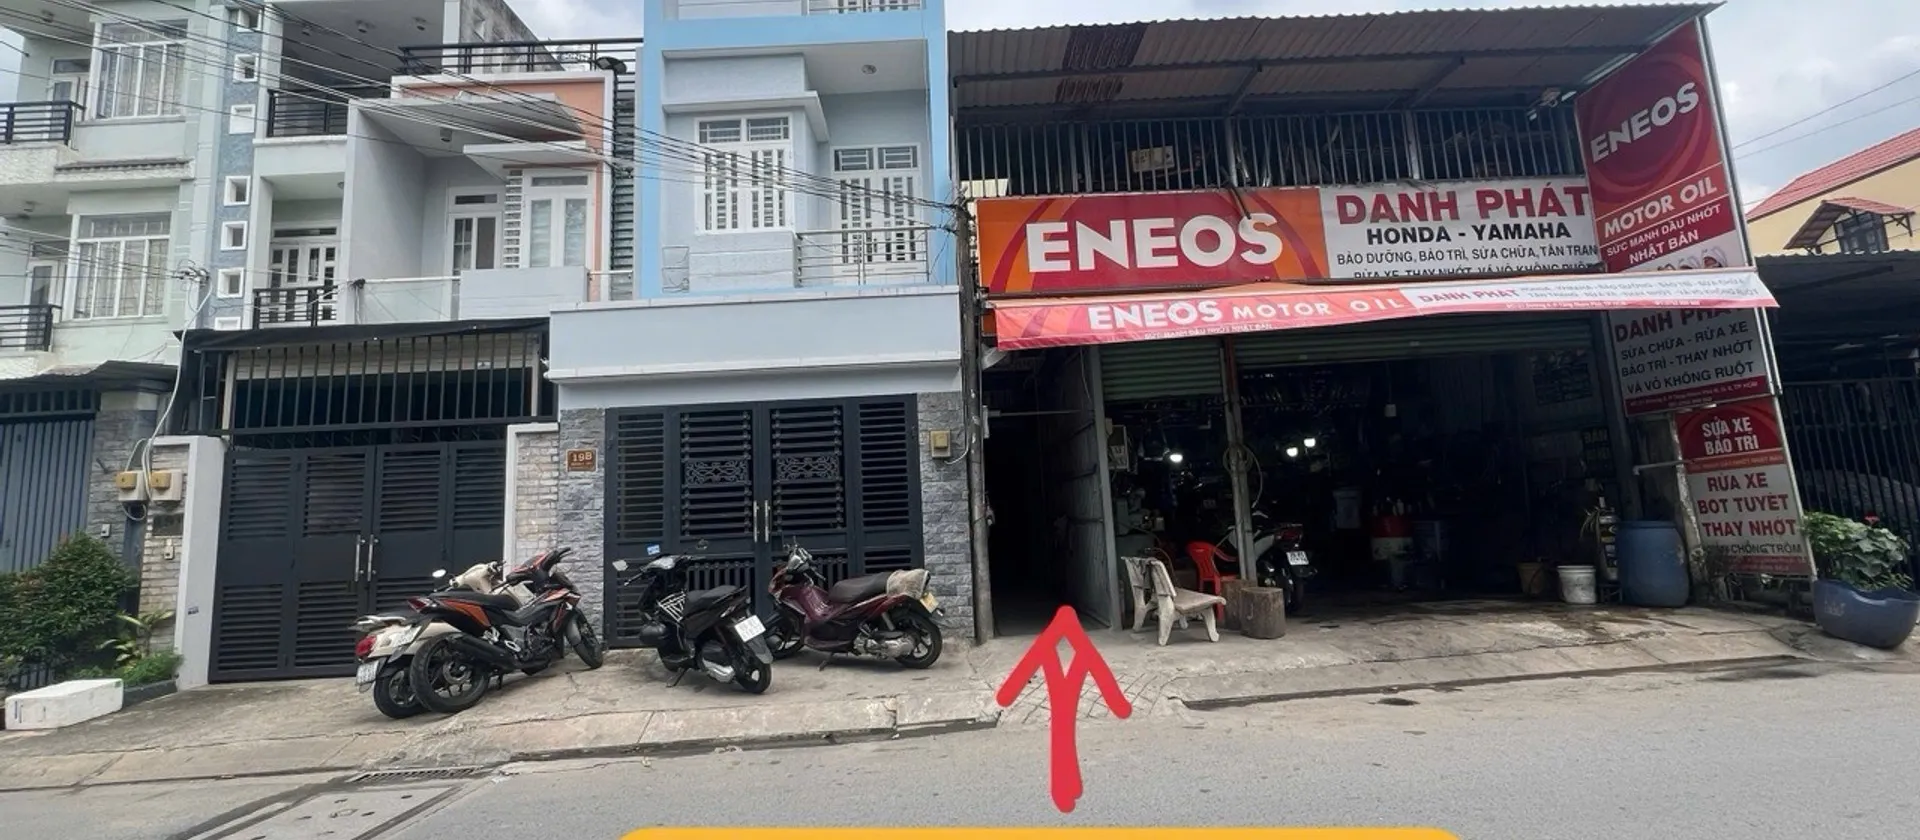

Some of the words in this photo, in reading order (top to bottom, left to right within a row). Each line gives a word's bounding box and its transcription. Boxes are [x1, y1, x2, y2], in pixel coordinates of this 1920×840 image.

[1590, 82, 1699, 163] ENEOS
[1336, 190, 1460, 225] DANH
[1476, 182, 1590, 220] PHÁT
[1604, 195, 1675, 238] MOTOR
[1680, 177, 1717, 204] OIL
[1026, 213, 1283, 273] ENEOS
[1366, 226, 1451, 245] HONDA
[1471, 222, 1571, 241] YAMAHA
[1337, 251, 1363, 265] BẢO
[1419, 248, 1444, 261] BẢO
[1629, 240, 1665, 264] NHẬT
[1668, 229, 1699, 250] BẢN
[1087, 299, 1223, 330] ENEOS
[1233, 302, 1330, 319] MOTOR
[1351, 297, 1405, 312] OIL
[1615, 311, 1673, 342] DANH
[1729, 321, 1748, 335] XE
[1676, 350, 1708, 366] THAY
[1664, 369, 1711, 387] KHÔNG
[1732, 417, 1753, 433] XE
[571, 452, 592, 462] 19B
[1744, 472, 1768, 489] XE
[1702, 521, 1743, 537] THAY
